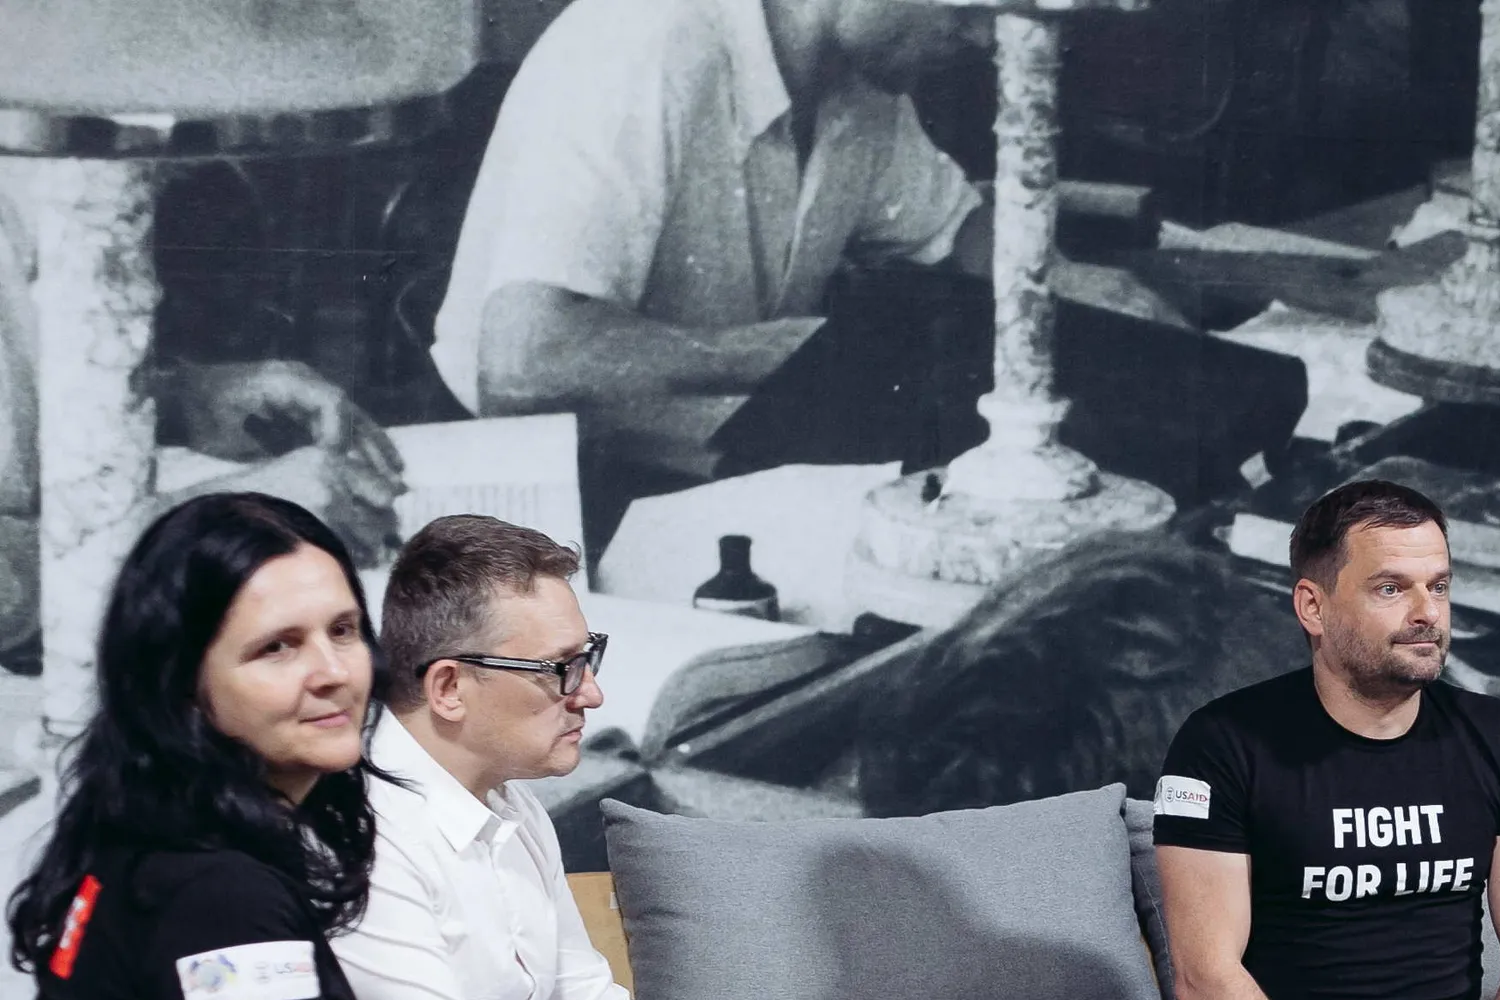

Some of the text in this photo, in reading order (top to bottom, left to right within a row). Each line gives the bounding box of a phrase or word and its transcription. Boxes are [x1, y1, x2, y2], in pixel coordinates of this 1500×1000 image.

[1175, 789, 1208, 802] USAID
[1333, 804, 1443, 848] FIGHT
[1301, 858, 1474, 901] FOR LIFE
